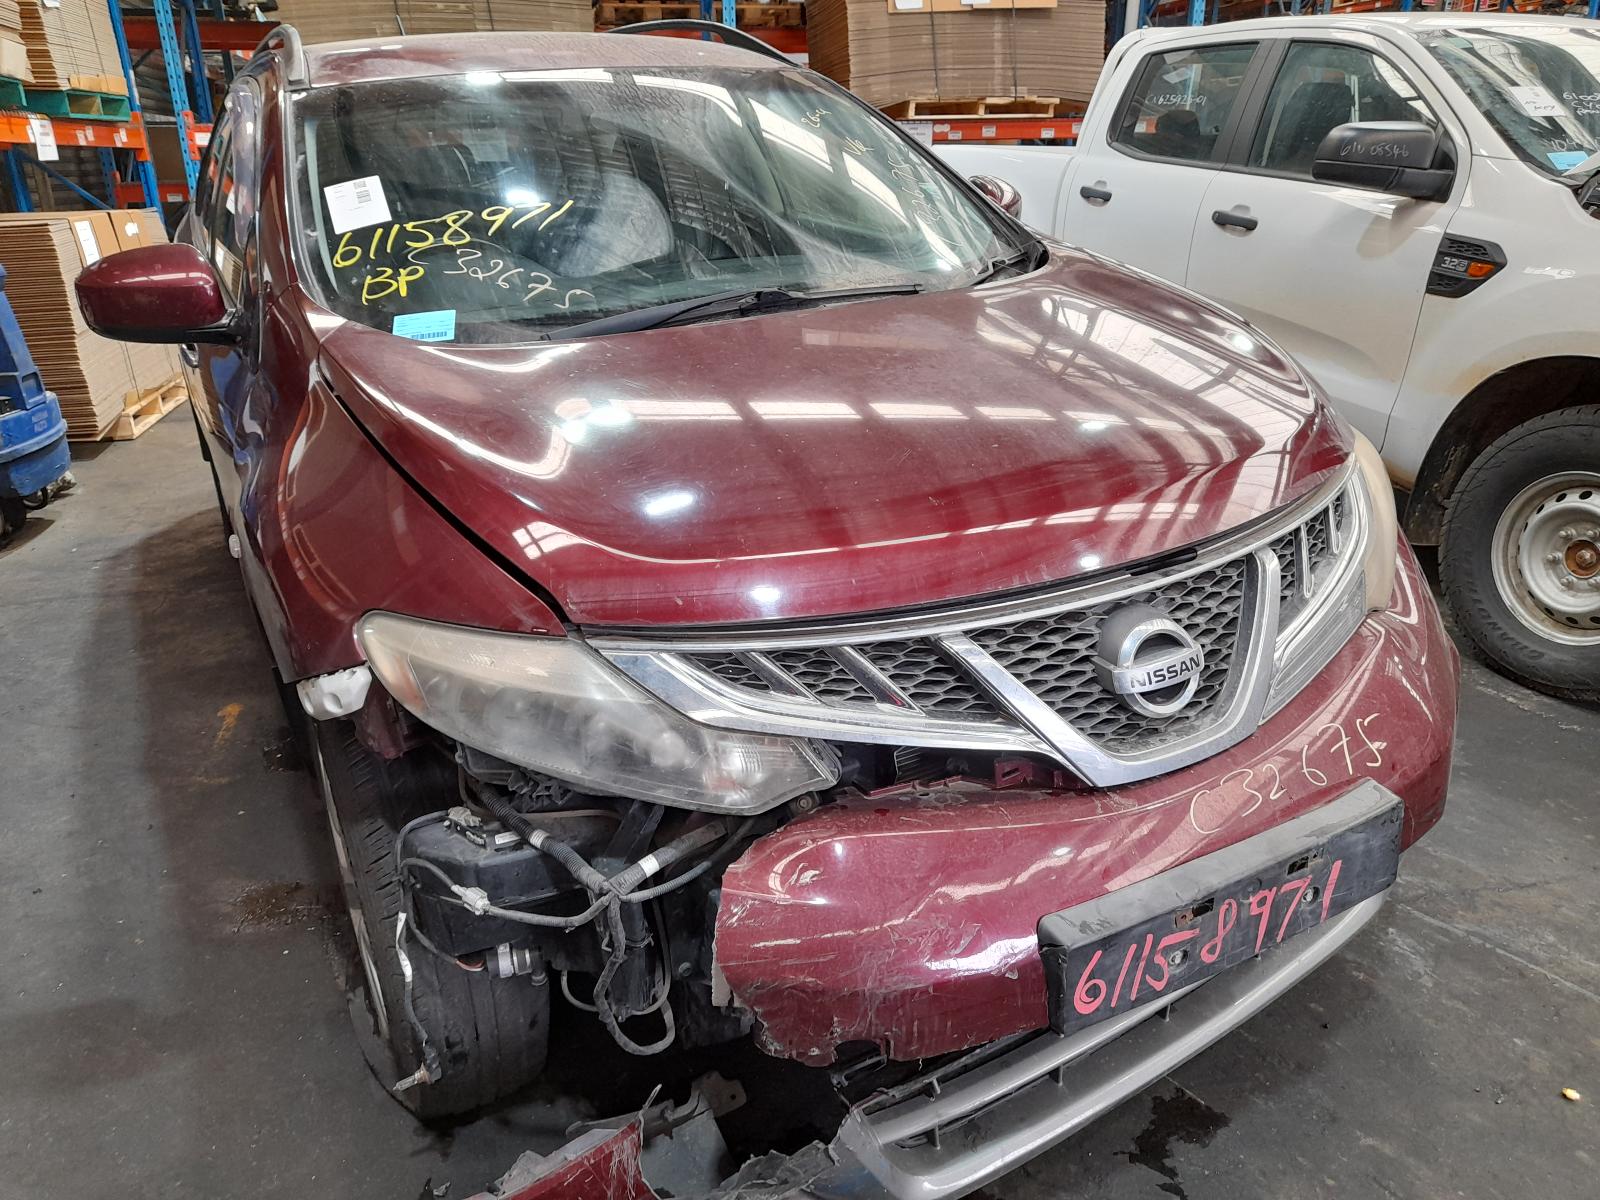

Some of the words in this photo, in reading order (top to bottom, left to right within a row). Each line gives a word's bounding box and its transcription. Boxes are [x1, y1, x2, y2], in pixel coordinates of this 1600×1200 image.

[333, 200, 574, 268] 61158971
[361, 265, 425, 306] BP
[1130, 653, 1201, 689] NISSAN
[1190, 713, 1383, 834] C32675
[1073, 859, 1342, 1015] 61158971
